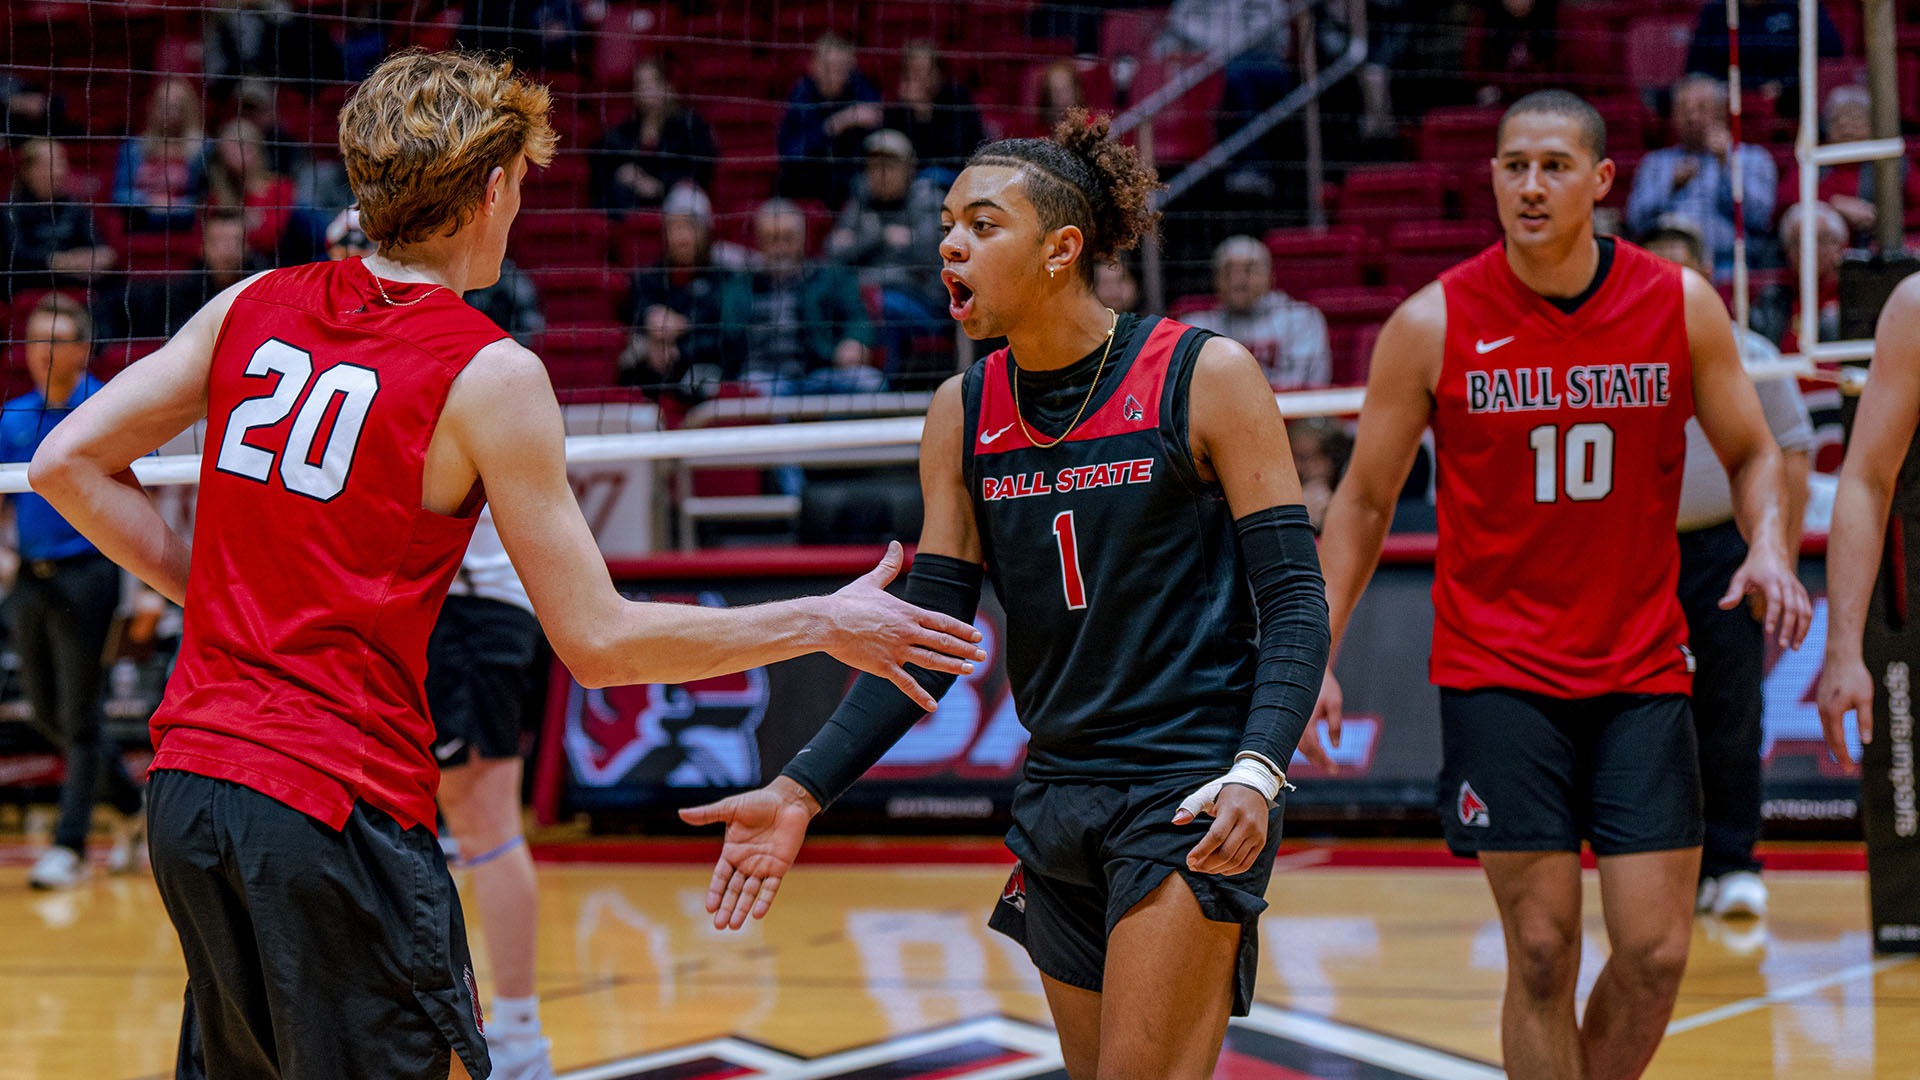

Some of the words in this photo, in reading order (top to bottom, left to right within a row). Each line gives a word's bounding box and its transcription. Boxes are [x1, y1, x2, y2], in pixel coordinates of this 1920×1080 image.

[215, 335, 381, 504] 20
[1466, 369, 1562, 414] BALL
[1565, 362, 1671, 410] STATE
[982, 471, 1052, 501] BALL
[1055, 457, 1155, 493] STATE
[1528, 422, 1615, 504] 10
[1052, 509, 1088, 611] 1
